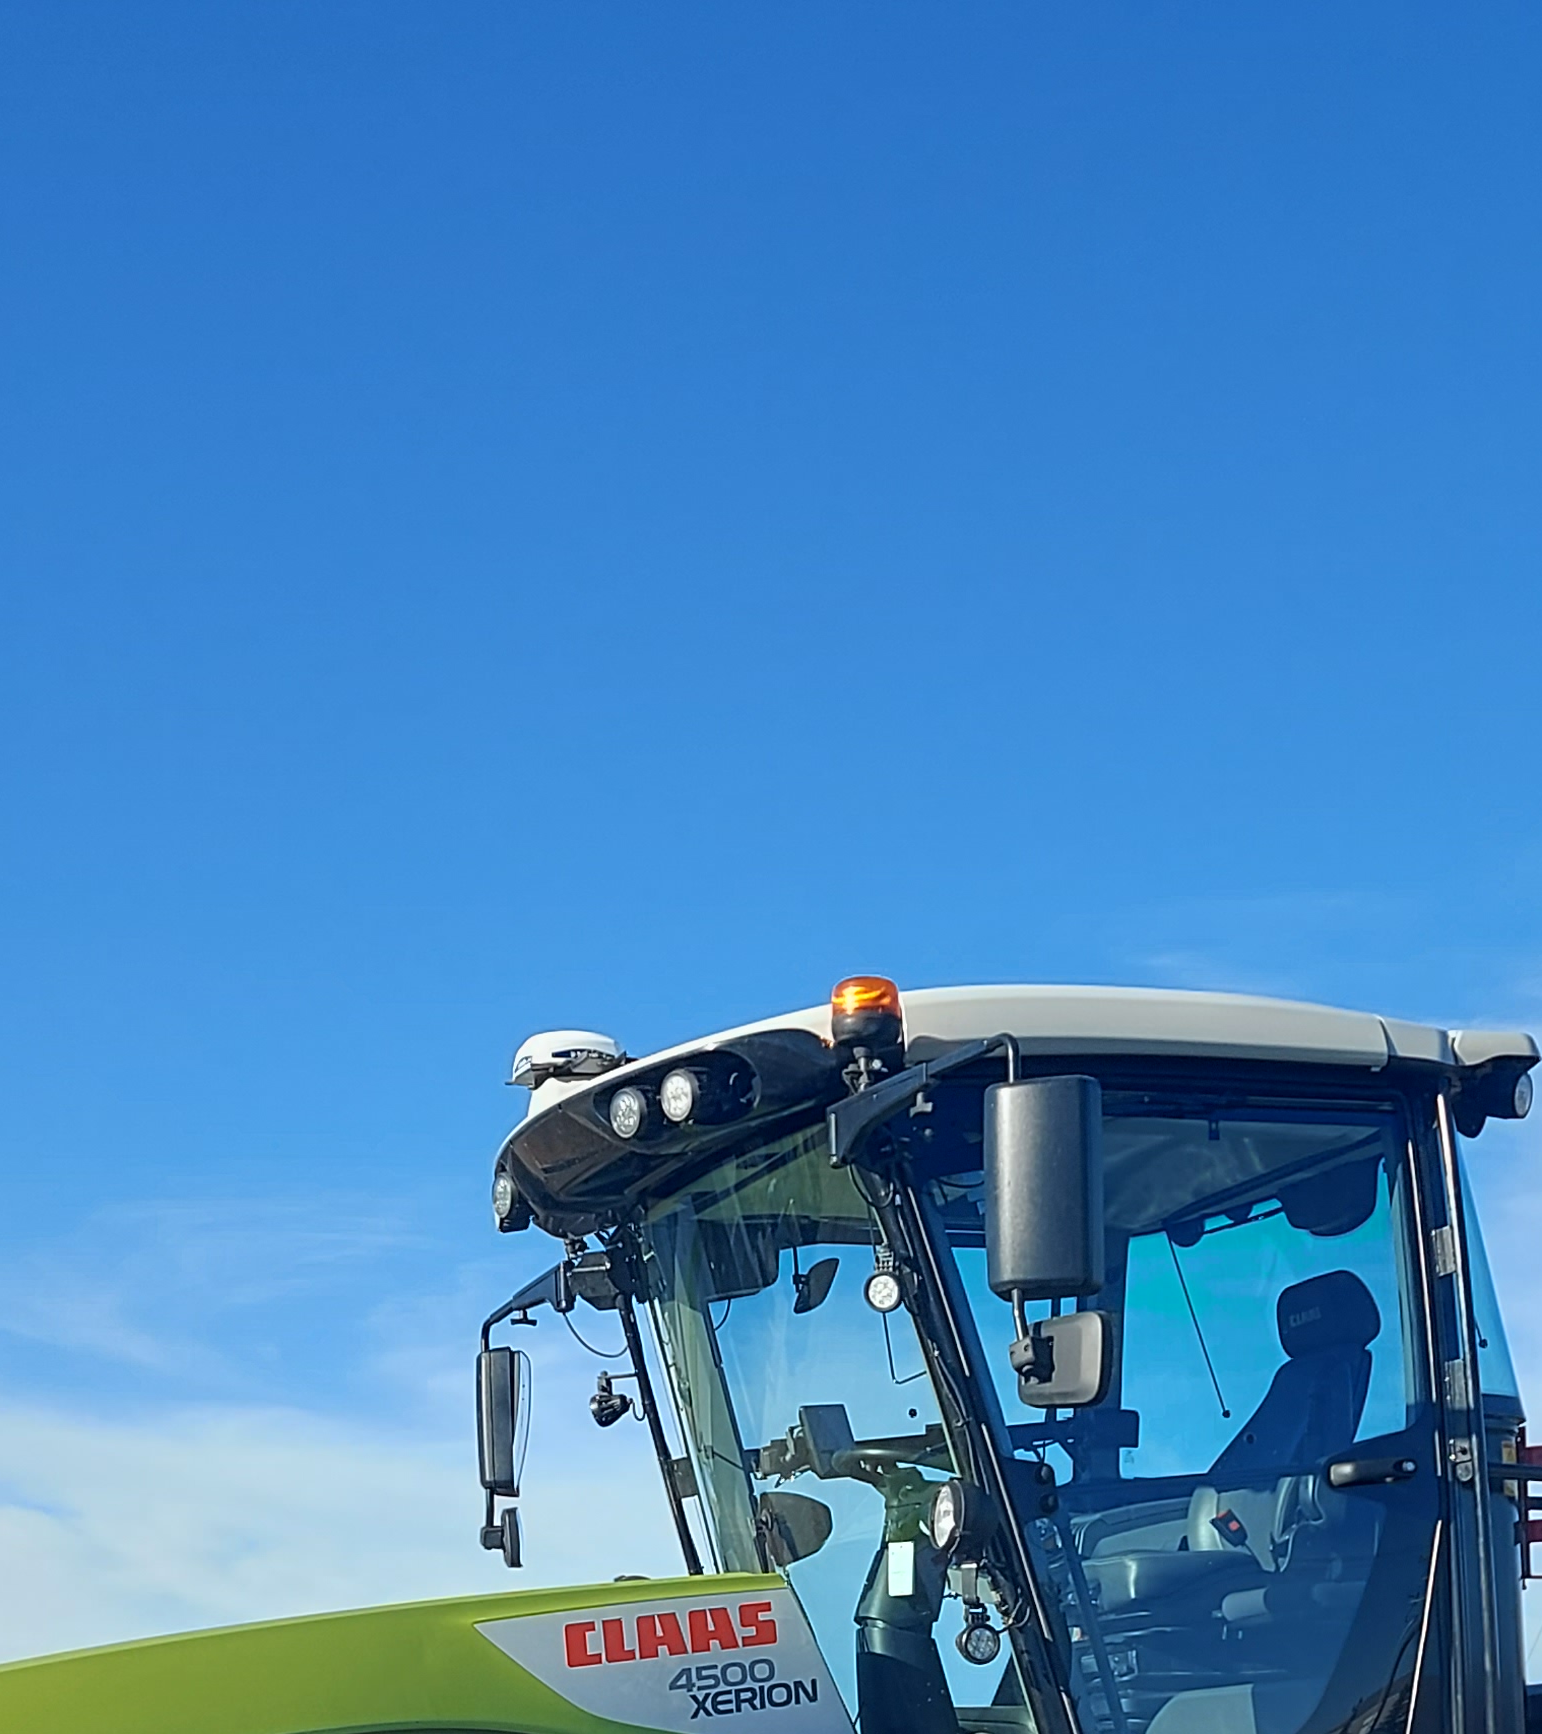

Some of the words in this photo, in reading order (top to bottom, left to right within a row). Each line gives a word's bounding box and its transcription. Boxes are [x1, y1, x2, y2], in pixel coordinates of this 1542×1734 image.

[562, 1600, 778, 1669] CLAAS
[668, 1657, 776, 1693] 4500
[689, 1677, 819, 1720] XERION
